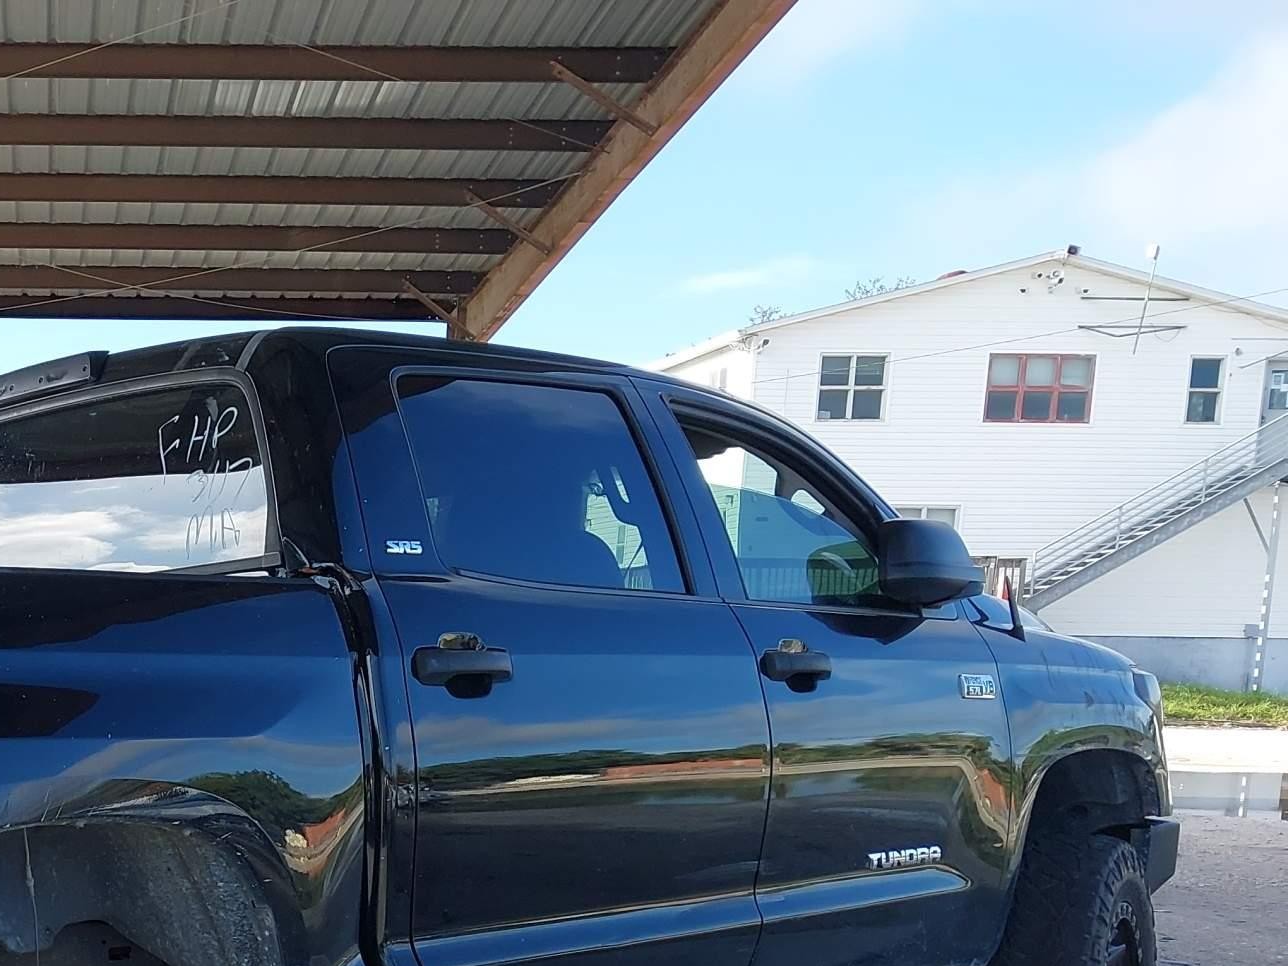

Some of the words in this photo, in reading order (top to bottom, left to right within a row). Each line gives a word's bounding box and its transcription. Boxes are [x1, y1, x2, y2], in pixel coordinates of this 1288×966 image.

[158, 406, 238, 486] FHP
[386, 540, 423, 554] SR5
[867, 845, 942, 870] TUNDRA
